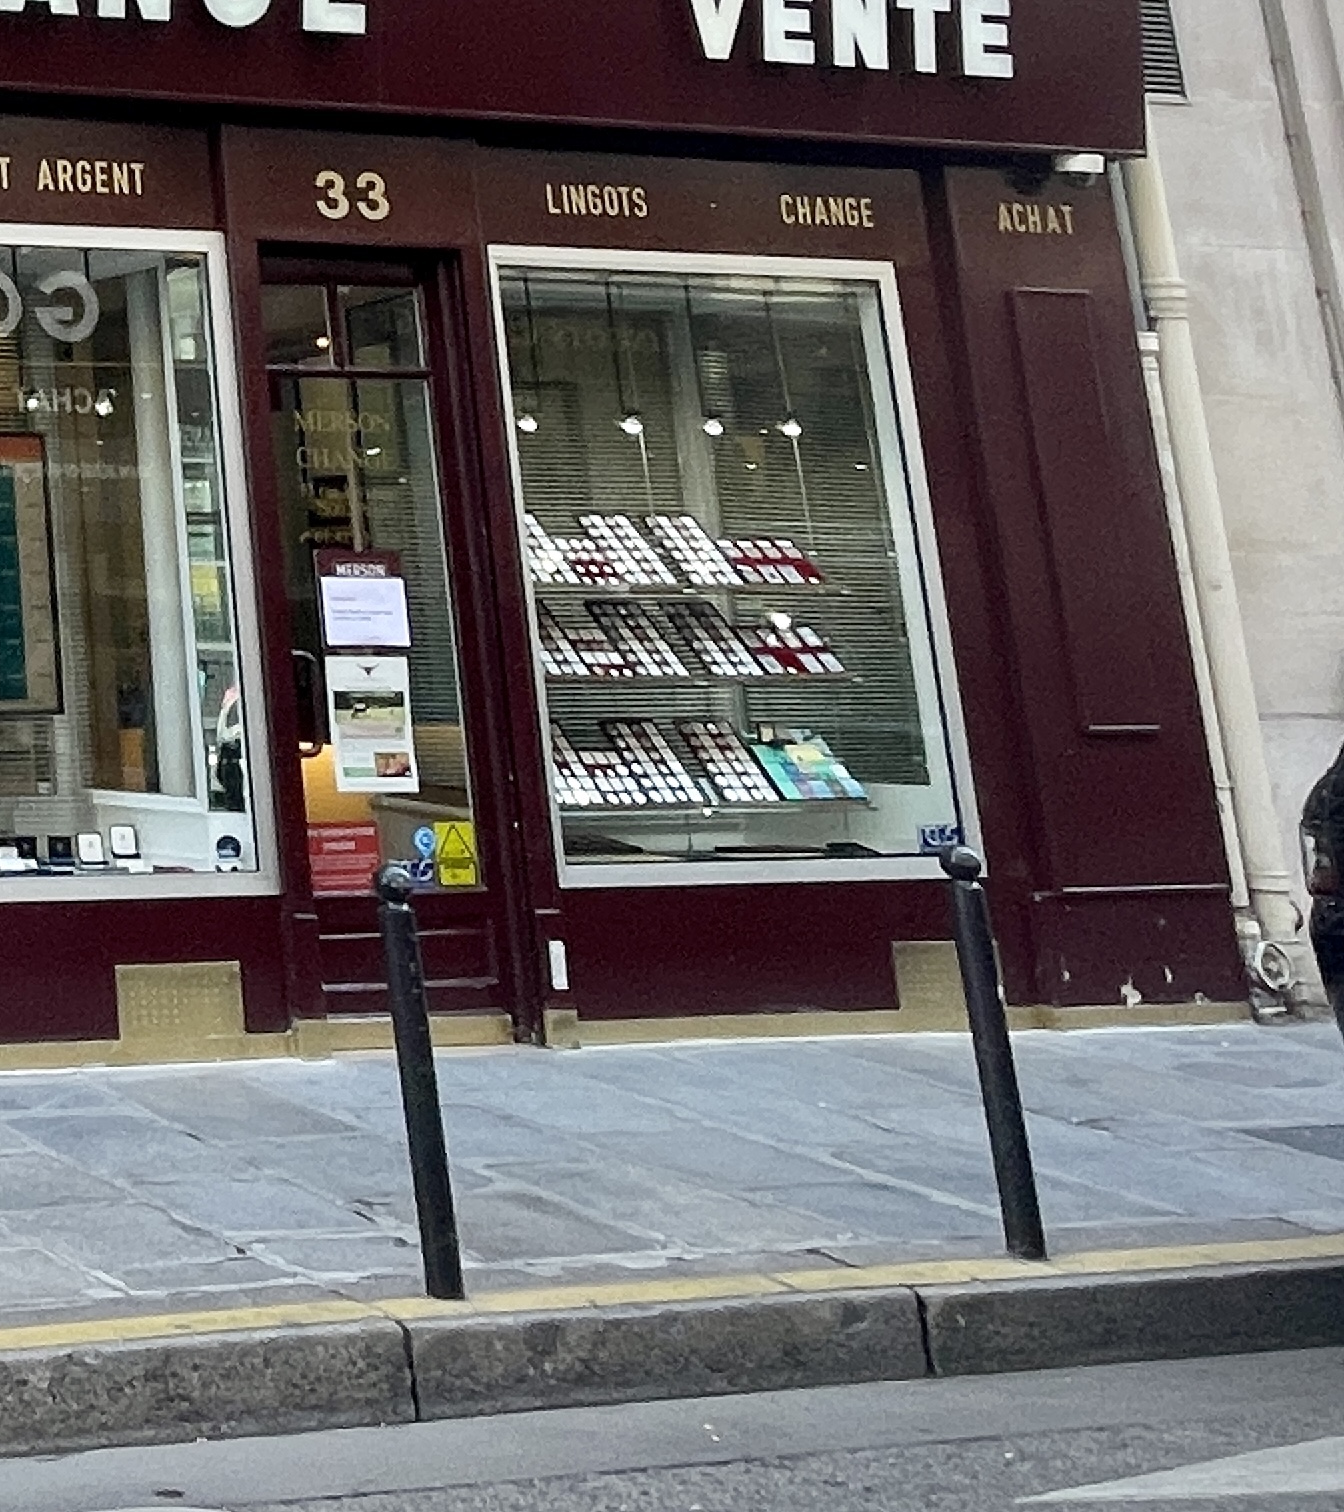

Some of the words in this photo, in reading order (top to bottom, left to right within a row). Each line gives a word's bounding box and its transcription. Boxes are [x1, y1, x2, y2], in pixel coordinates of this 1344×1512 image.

[37, 159, 146, 198] ARGENT
[314, 169, 392, 222] 33
[545, 182, 649, 218] LINGOTS
[779, 194, 876, 229] CHANGE
[997, 201, 1075, 235] ACHAT
